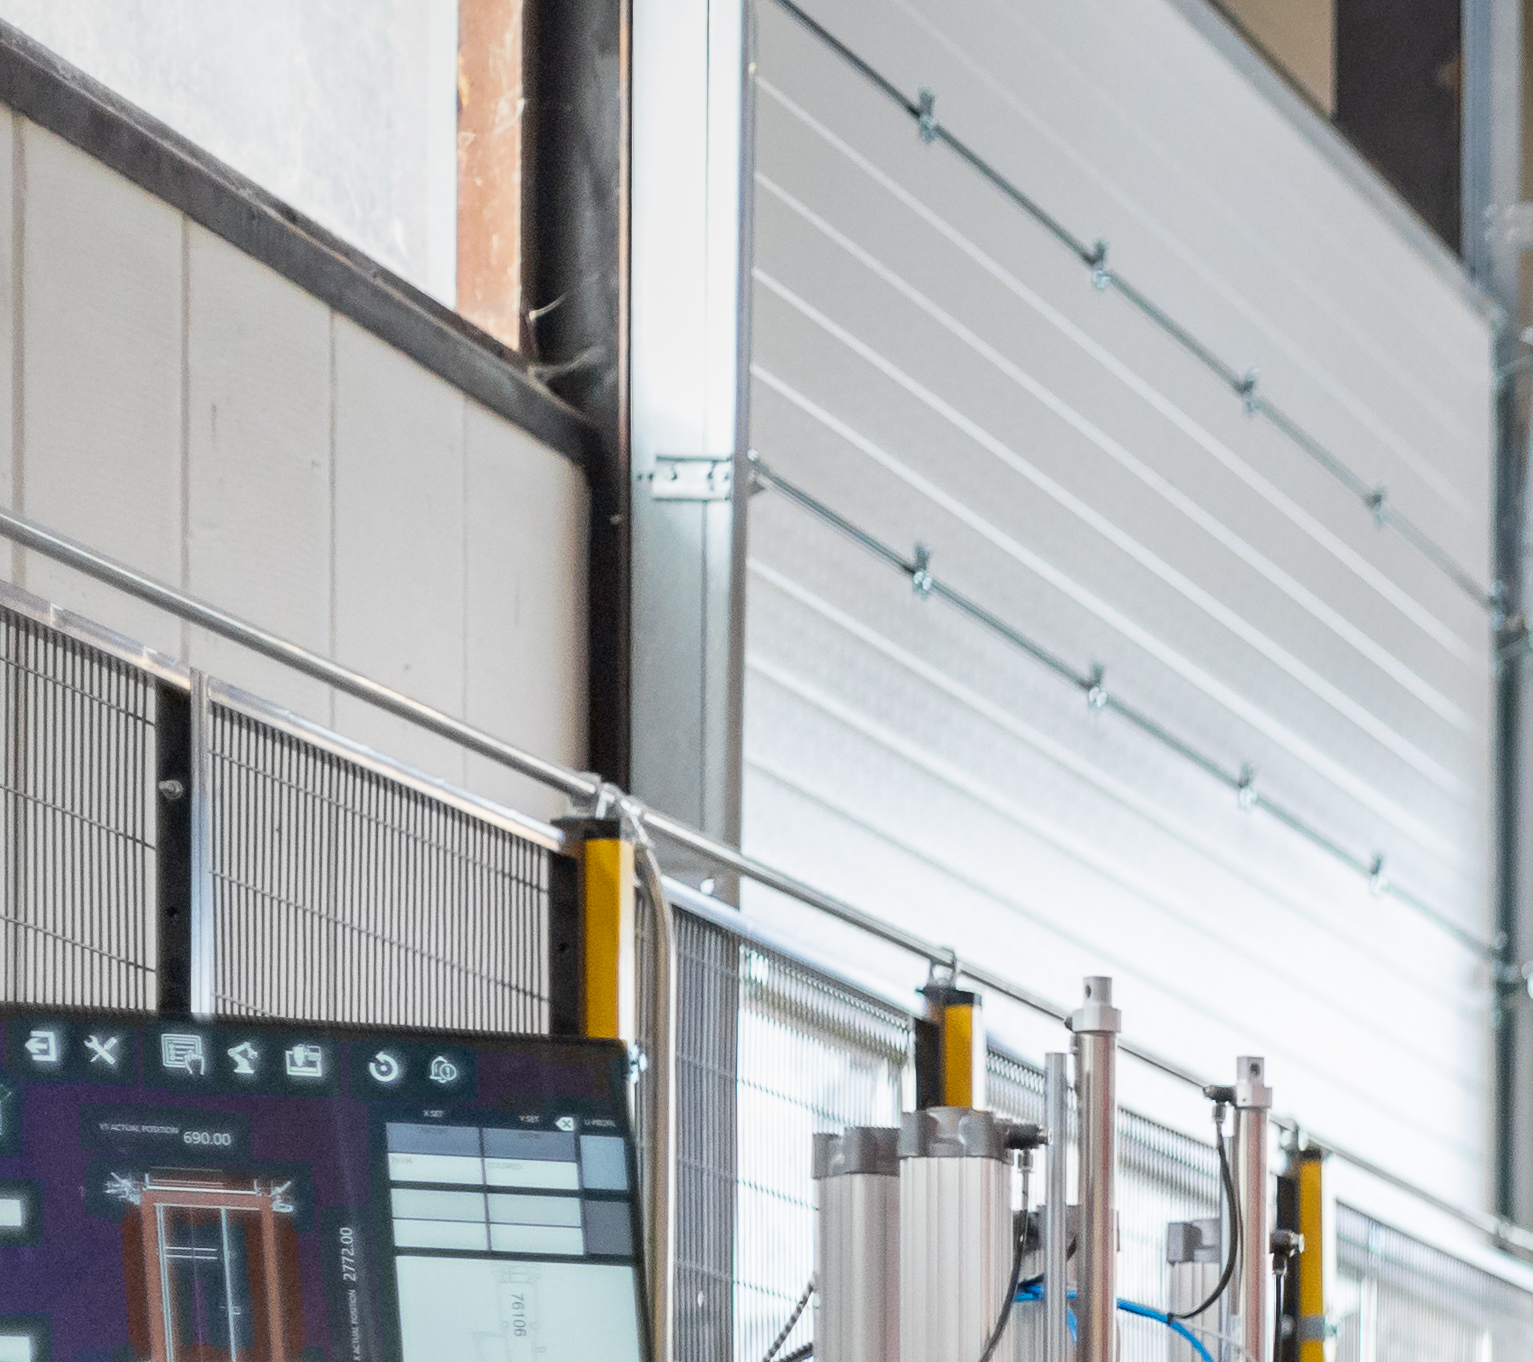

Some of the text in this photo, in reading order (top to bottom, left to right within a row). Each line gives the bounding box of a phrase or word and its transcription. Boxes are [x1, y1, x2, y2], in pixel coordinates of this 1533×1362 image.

[183, 1131, 232, 1146] 690.00
[339, 1227, 357, 1282] 2772.00
[511, 1293, 527, 1337] 76106
